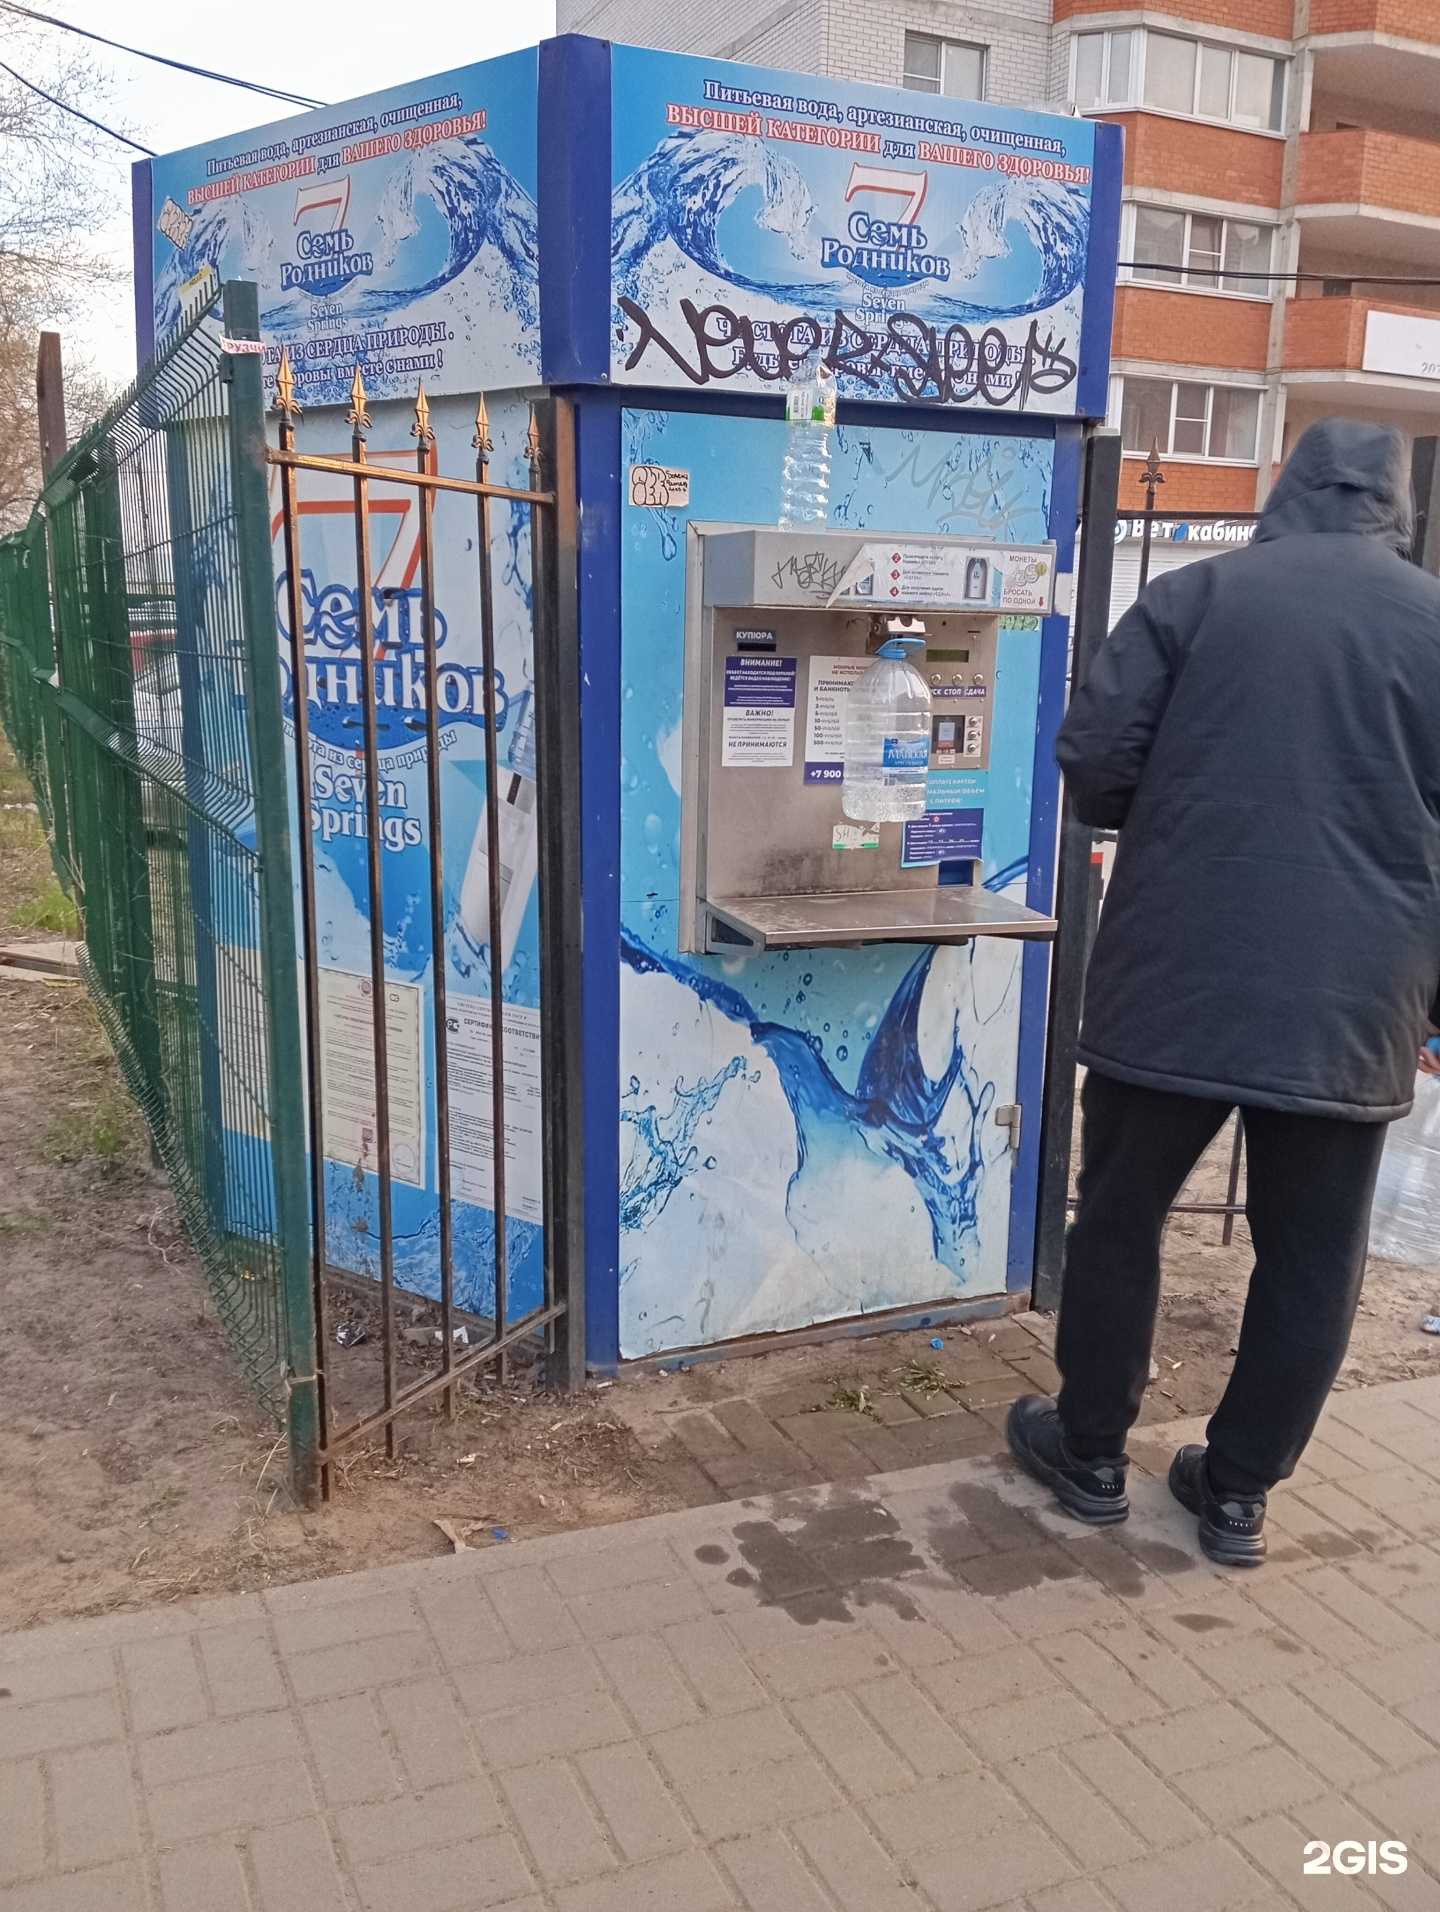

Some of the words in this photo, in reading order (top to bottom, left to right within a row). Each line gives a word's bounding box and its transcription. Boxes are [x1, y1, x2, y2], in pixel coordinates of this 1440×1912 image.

[703, 79, 793, 112] Питьевая
[796, 99, 843, 123] вода,
[847, 107, 967, 142] артезианская,
[969, 126, 1067, 158] очищенная,
[207, 149, 259, 177] Питьевая
[260, 142, 290, 162] вода,
[291, 117, 379, 154] артезианская,
[380, 92, 463, 129] очищенная,
[666, 103, 763, 137] ВЫСШЕЙ
[766, 118, 881, 153] КАТЕГОРИИ
[882, 140, 916, 160] для
[917, 139, 996, 171] ВАШЕГО
[997, 153, 1092, 185] ЗДОРОВЬЯ!
[186, 173, 242, 206] ВЫСШЕЙ
[241, 155, 317, 192] КАТЕГОРИИ
[316, 152, 341, 176] для
[342, 132, 402, 166] ВАШЕГО
[402, 109, 488, 150] ЗДОРОВЬЯ!
[293, 174, 352, 231] 7
[843, 161, 929, 228] 7
[848, 210, 928, 250] Семь
[297, 229, 355, 260] Семь
[280, 252, 374, 290] Родников
[821, 238, 951, 280] Родников
[311, 302, 344, 319] Seven
[862, 291, 906, 313] Seven
[307, 316, 349, 334] Springs
[306, 333, 366, 360] СЕРДЦА
[337, 361, 384, 380] вмсте
[384, 360, 395, 374] с
[1009, 554, 1038, 563] МОНЕТЫ
[736, 631, 773, 640] КУПЮРА
[740, 658, 783, 668] ВНИМАНИЕ!
[944, 688, 962, 697] СТОП
[963, 688, 986, 697] СДАЧА
[745, 709, 775, 717] ВАЖНО!
[737, 741, 787, 749] ПРИНИМАЮТСЯ
[313, 764, 408, 809] Seven
[823, 769, 842, 779] 900
